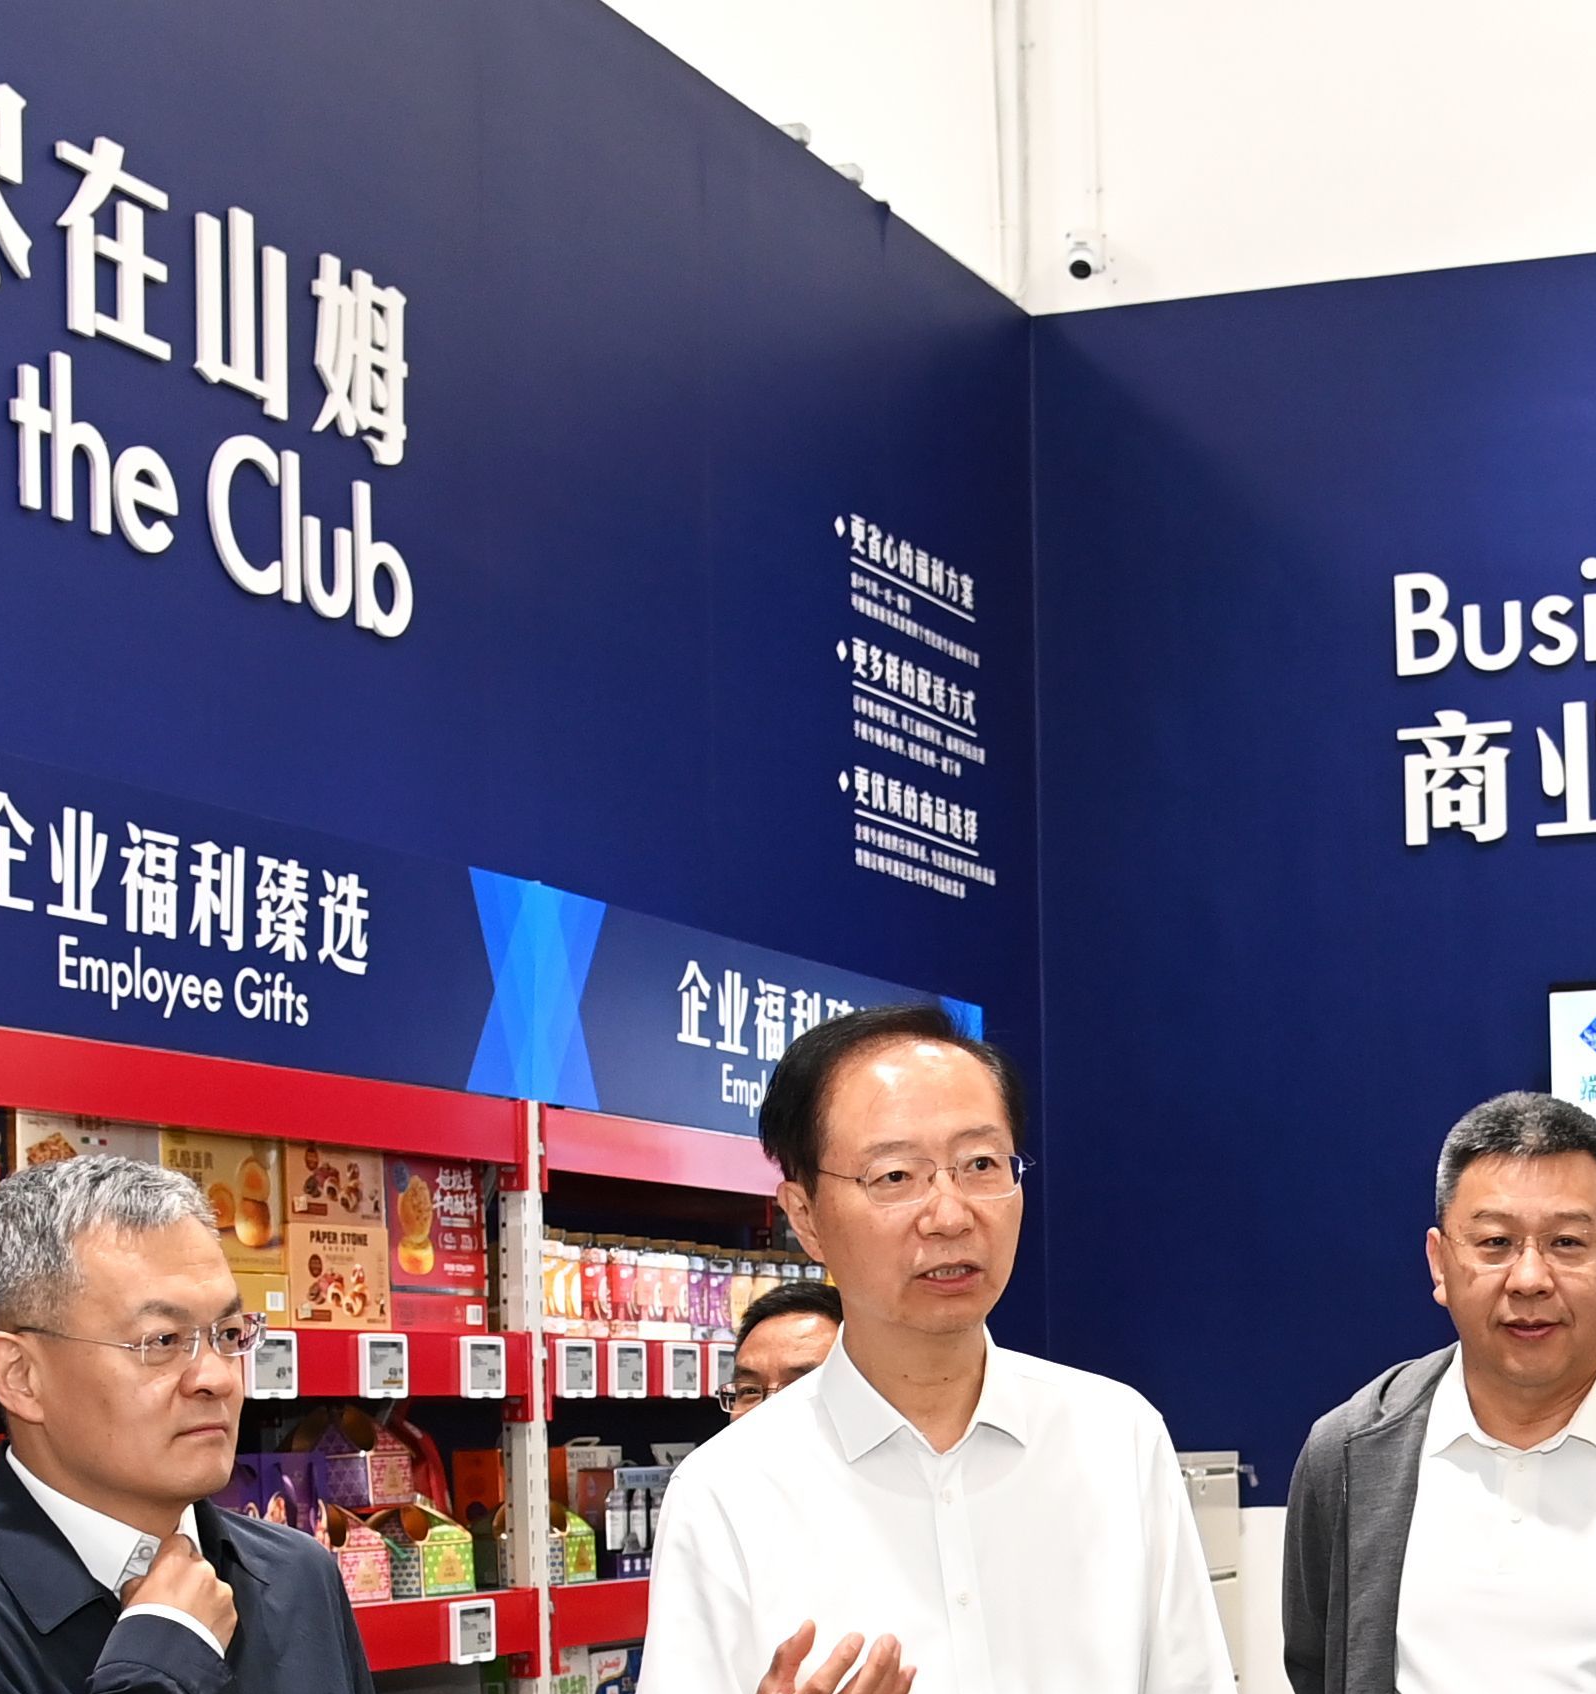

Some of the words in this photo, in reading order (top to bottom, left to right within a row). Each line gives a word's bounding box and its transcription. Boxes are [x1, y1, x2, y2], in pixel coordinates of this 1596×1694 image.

[10, 350, 179, 554] the
[207, 434, 413, 638] Club
[852, 637, 976, 726] 更多样的配送方式
[854, 766, 978, 845] 更优质的商品选择
[59, 936, 222, 1023] Employee
[234, 965, 309, 1027] Gifts
